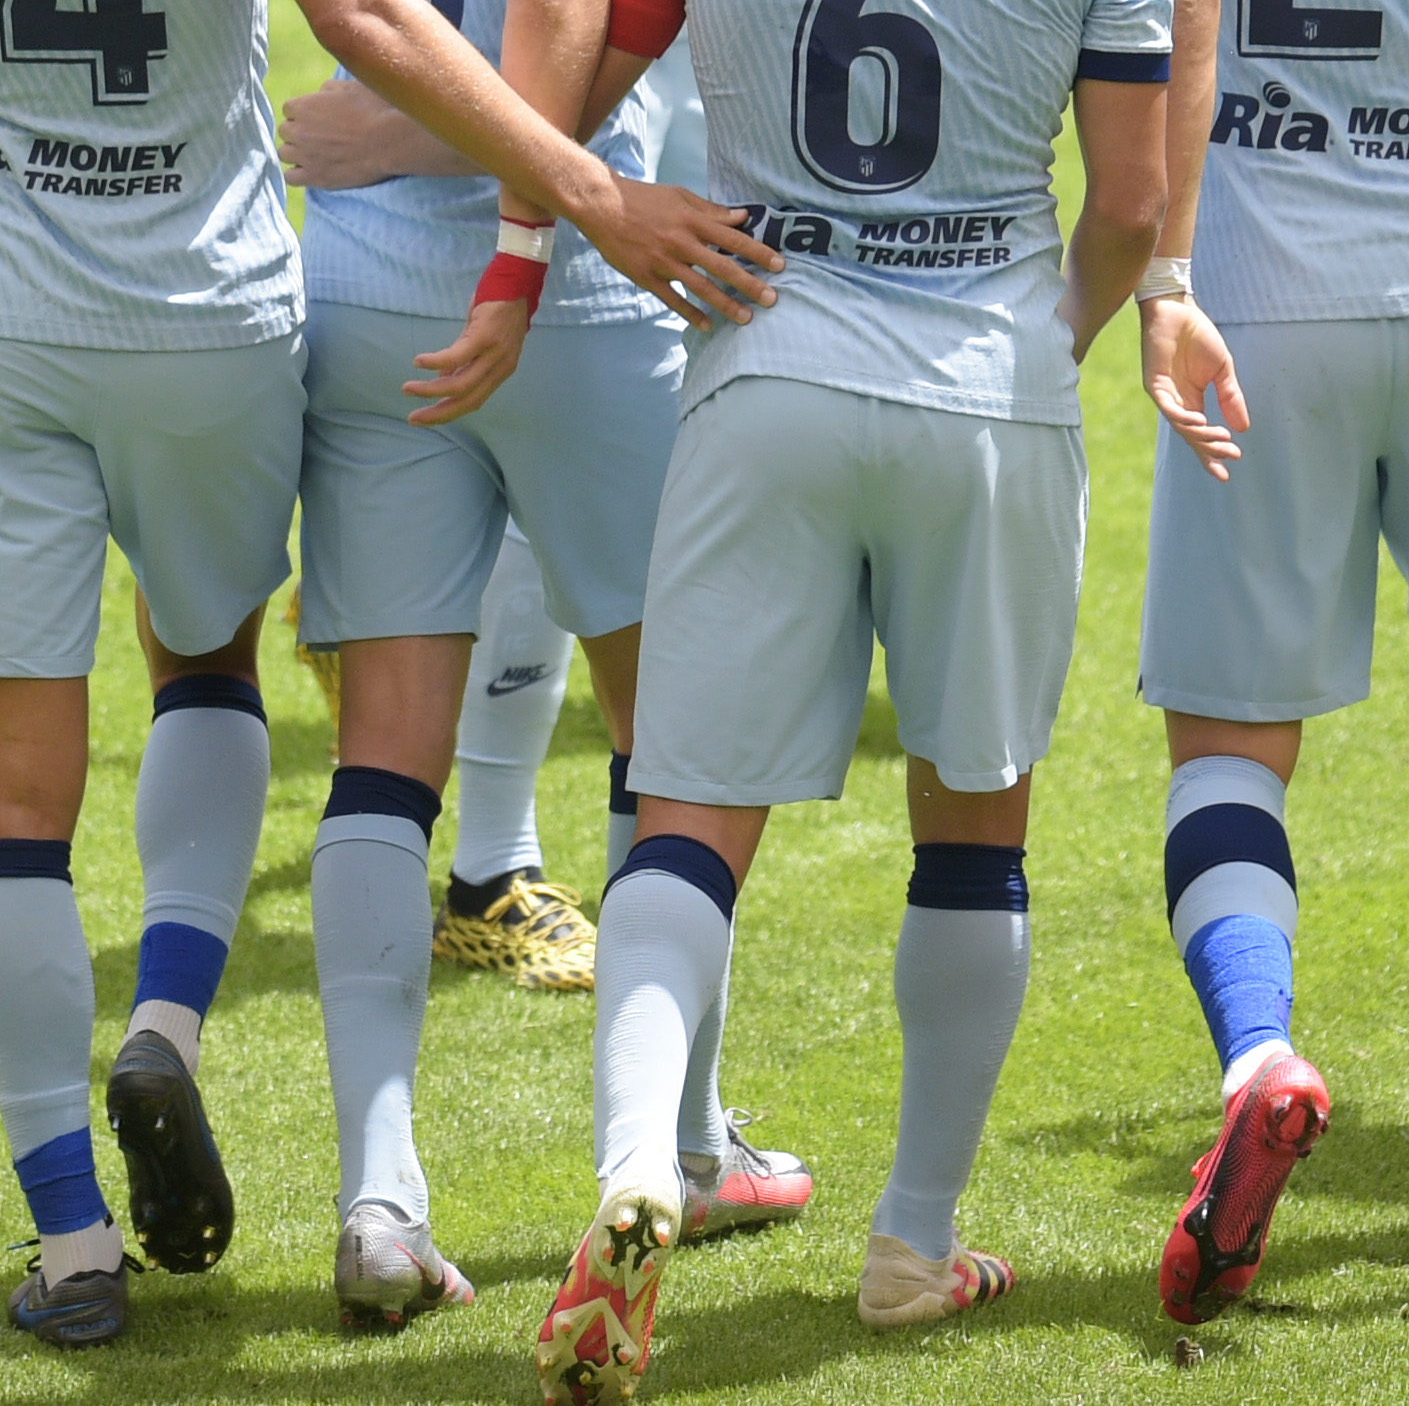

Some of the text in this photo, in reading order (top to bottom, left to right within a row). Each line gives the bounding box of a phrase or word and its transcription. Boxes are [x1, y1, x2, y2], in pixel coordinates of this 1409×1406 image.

[1209, 81, 1328, 152] Ria
[27, 138, 188, 173] MONEY
[22, 170, 183, 197] TRANSFER
[858, 215, 1018, 245] MONEY
[855, 244, 1012, 268] TRANSFER
[501, 663, 546, 683] NIKE
